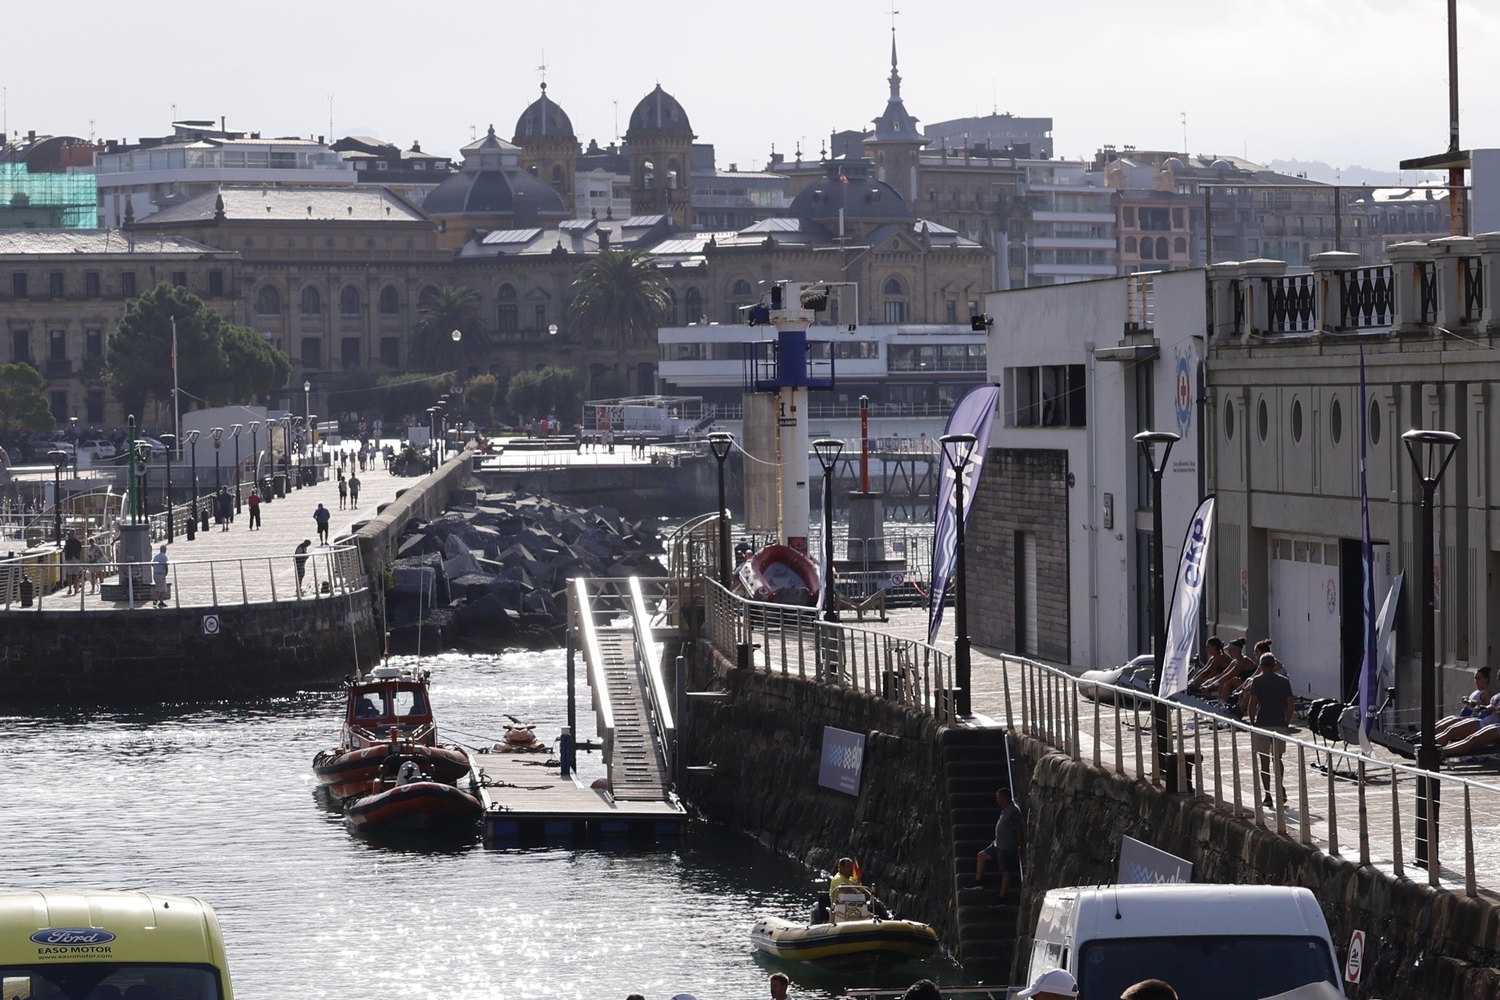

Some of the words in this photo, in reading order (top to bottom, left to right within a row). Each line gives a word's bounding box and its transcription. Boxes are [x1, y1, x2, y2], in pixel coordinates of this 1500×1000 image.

[1185, 517, 1207, 587] ekp
[47, 930, 98, 943] Ford
[71, 946, 112, 954] MOTOR
